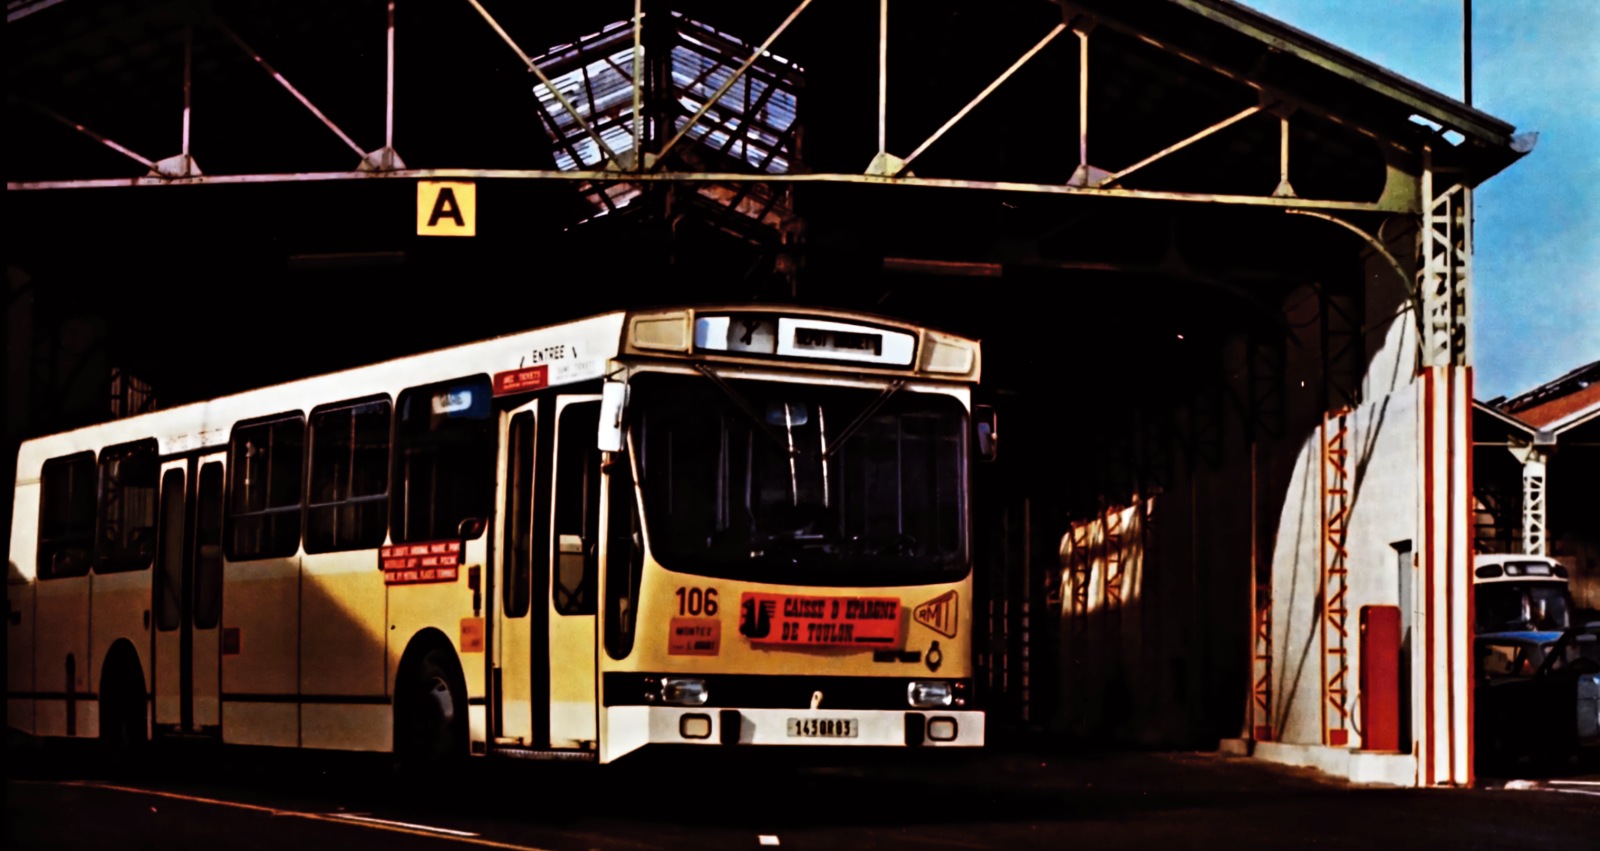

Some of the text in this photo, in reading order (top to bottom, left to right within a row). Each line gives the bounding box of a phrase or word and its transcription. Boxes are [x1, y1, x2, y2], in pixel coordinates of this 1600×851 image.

[427, 186, 465, 227] A
[532, 345, 565, 364] ENTREE
[675, 587, 718, 616] 106
[783, 597, 826, 619] CAISSE
[845, 599, 897, 620] EPARGNE
[781, 622, 855, 643] DE TOULON
